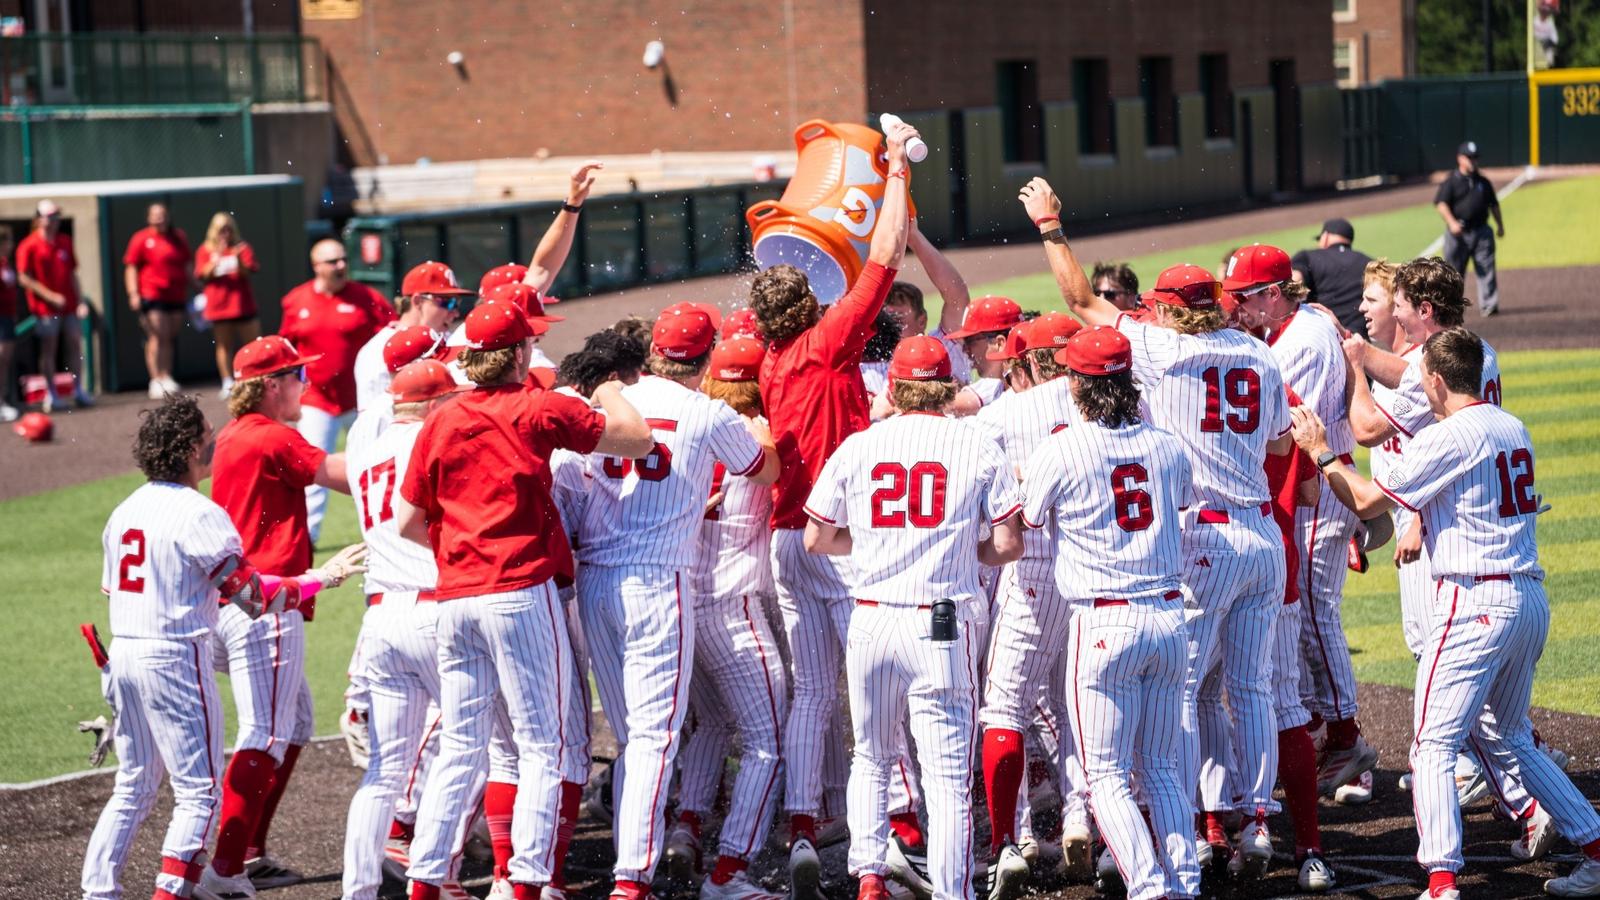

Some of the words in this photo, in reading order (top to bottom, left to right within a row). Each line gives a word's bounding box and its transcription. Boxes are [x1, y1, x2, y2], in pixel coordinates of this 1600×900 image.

[1563, 85, 1600, 116] 332
[833, 186, 876, 237] G
[912, 367, 938, 377] Miami
[1200, 367, 1261, 434] 19
[359, 456, 396, 532] 17
[871, 461, 948, 528] 20
[1111, 463, 1154, 532] 6
[1495, 448, 1537, 518] 12
[118, 528, 146, 593] 2
